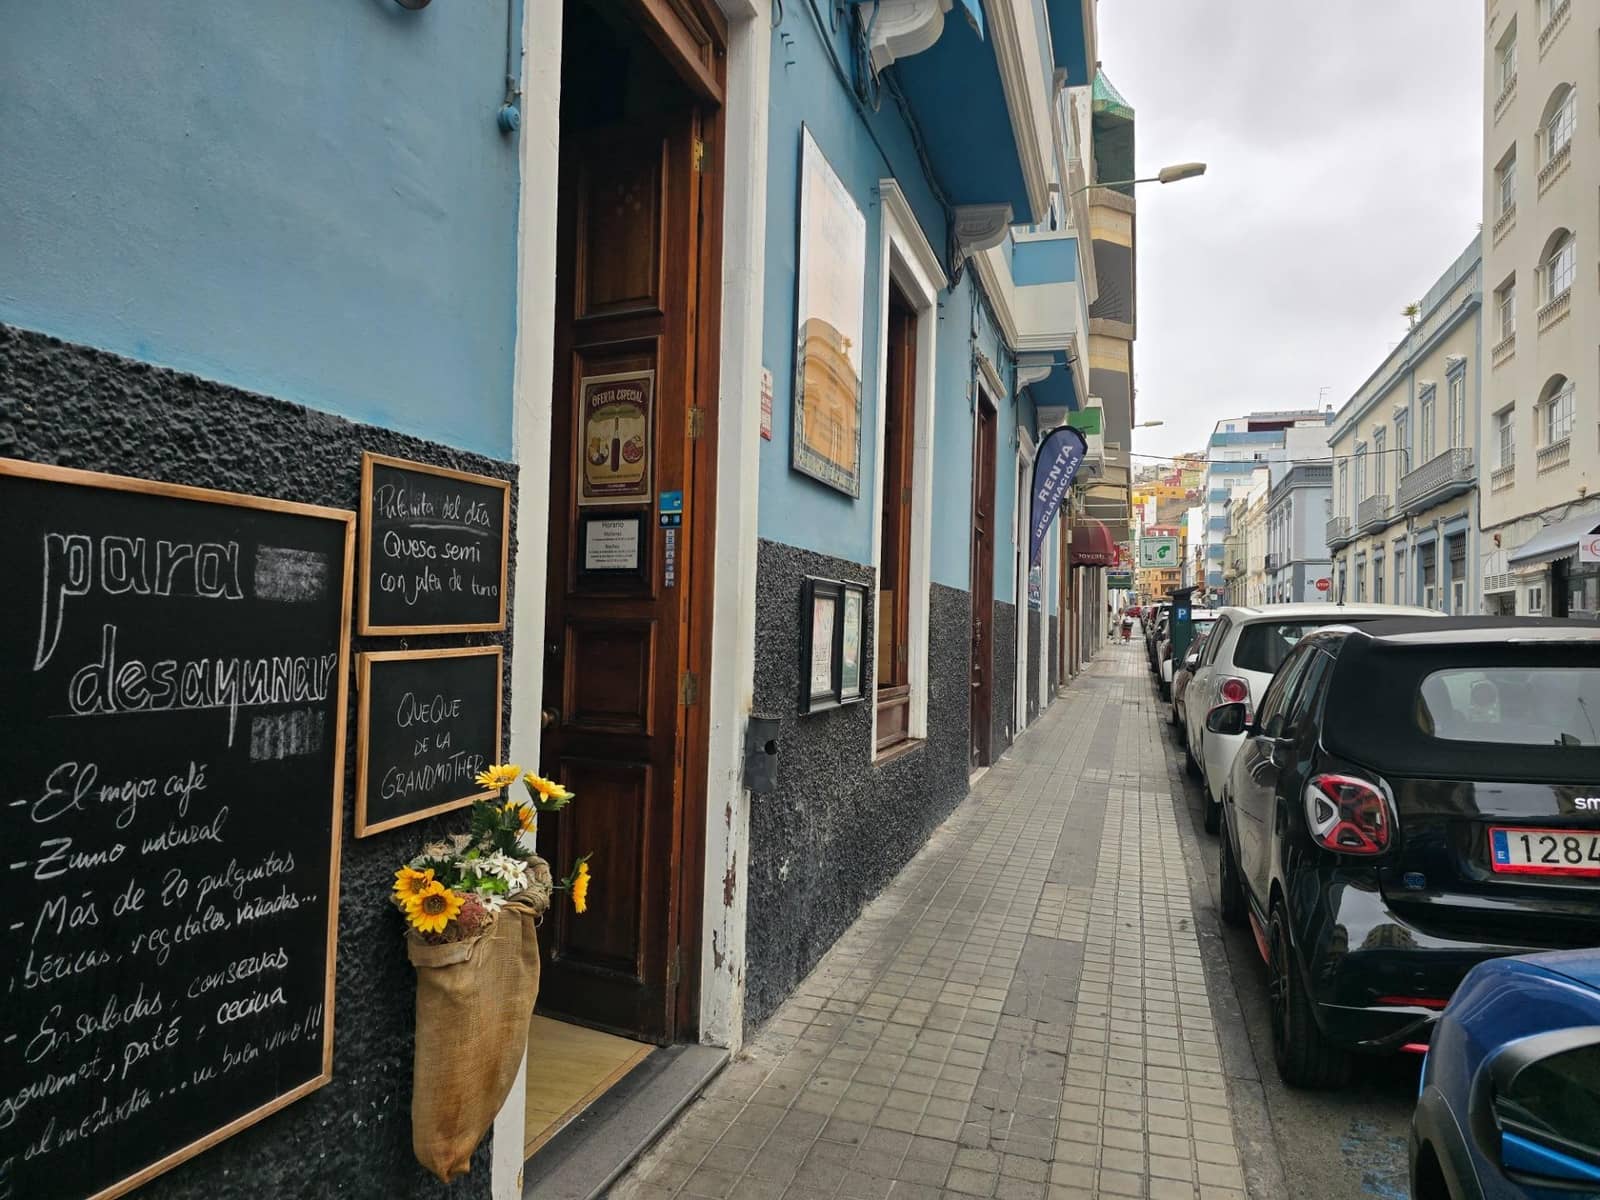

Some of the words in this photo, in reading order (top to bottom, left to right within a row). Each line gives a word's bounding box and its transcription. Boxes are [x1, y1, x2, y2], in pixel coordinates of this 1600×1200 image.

[592, 390, 615, 407] OFERTA
[616, 389, 643, 403] ESPECIAL
[1038, 445, 1074, 502] RENTA
[442, 494, 460, 520] del
[465, 501, 490, 528] día
[383, 530, 437, 559] Queso
[440, 542, 481, 563] semi
[34, 533, 244, 671] para
[380, 571, 406, 595] con
[448, 568, 463, 592] de
[1178, 608, 1186, 619] P
[69, 624, 337, 747] desayunar
[414, 737, 430, 758] DE
[435, 731, 450, 749] LA
[31, 762, 98, 823] El
[99, 777, 157, 829] mejor
[164, 761, 208, 817] café
[380, 750, 484, 800] GRANDMOTHER
[34, 838, 127, 880] Zumo
[142, 806, 229, 854] natural
[1497, 851, 1505, 859] E
[31, 891, 99, 945] Más
[113, 879, 146, 916] de
[162, 868, 188, 906] 20
[197, 851, 295, 912] pulguitas
[188, 947, 289, 998] conservas
[217, 986, 288, 1024] cecina
[25, 1116, 56, 1161] al
[193, 1067, 217, 1085] un
